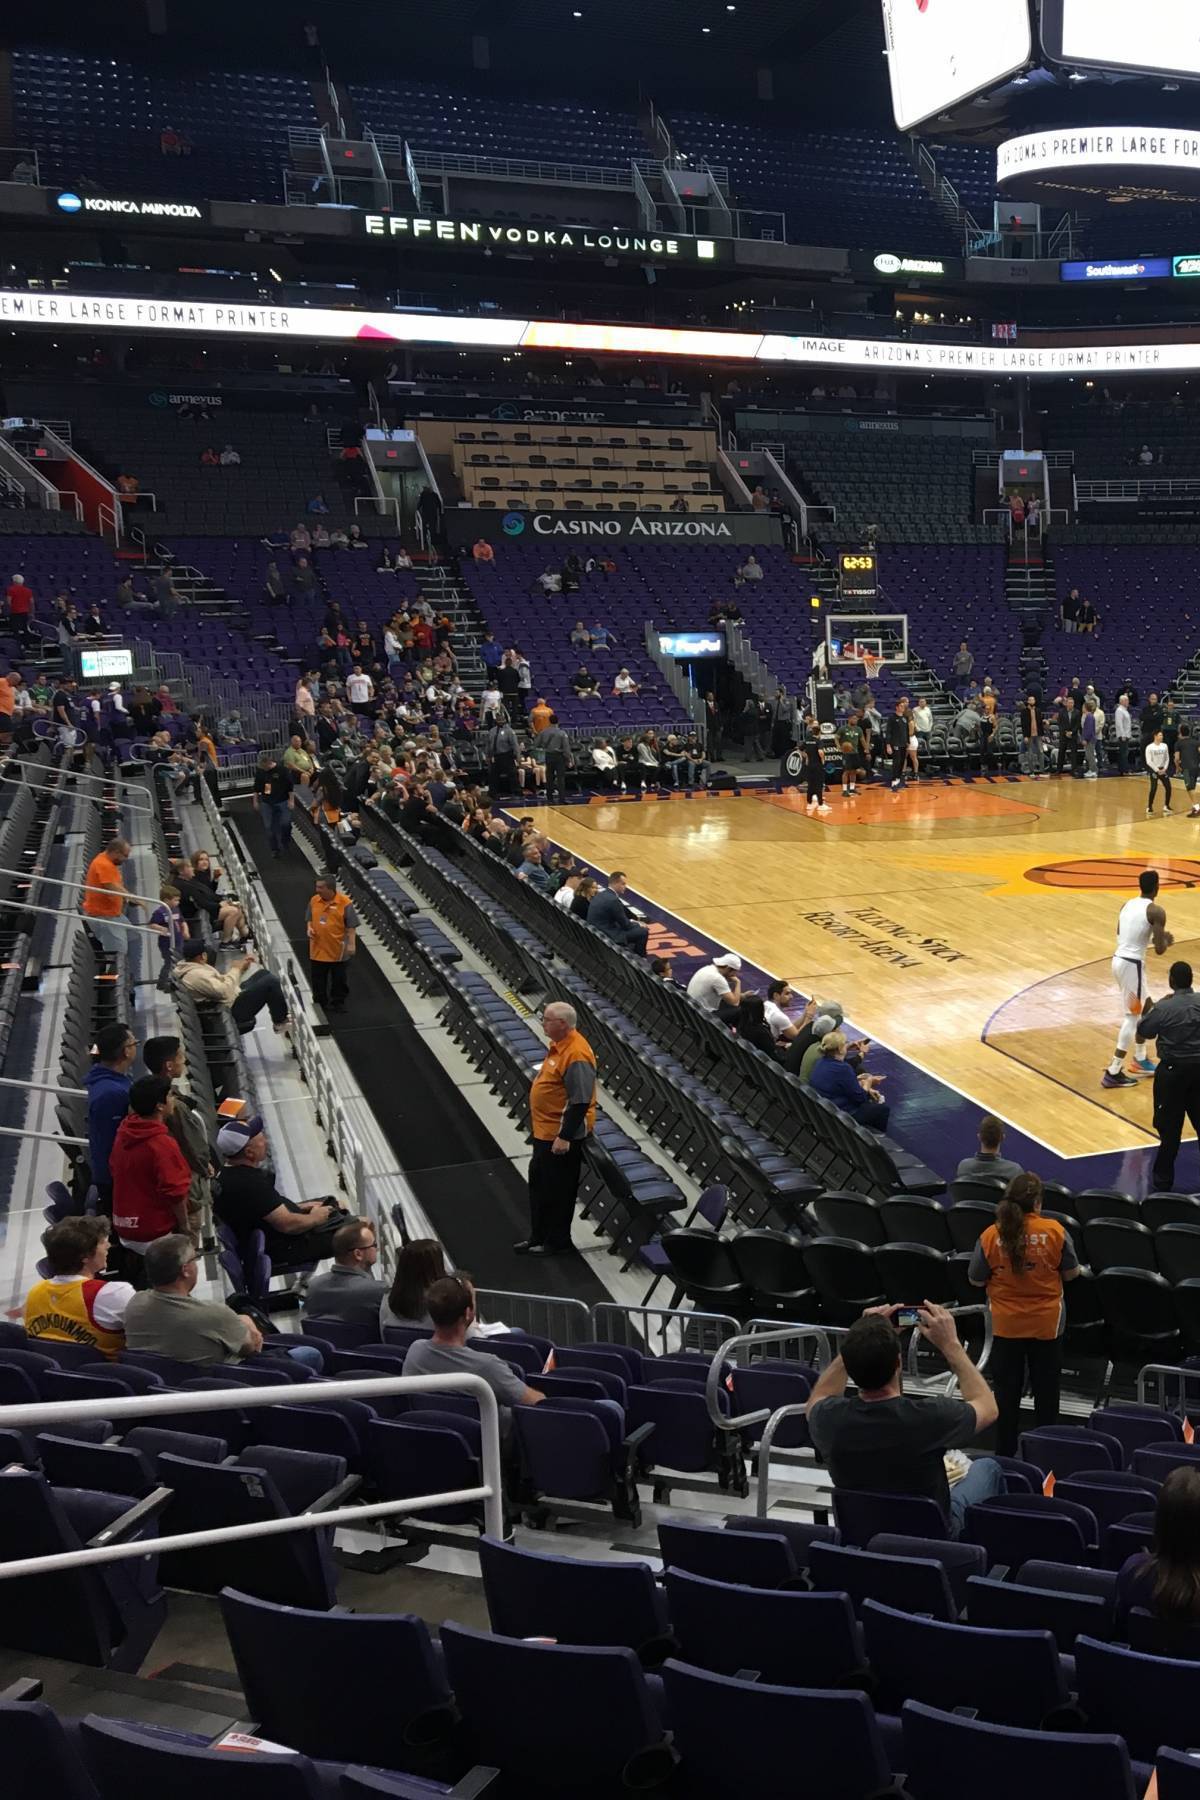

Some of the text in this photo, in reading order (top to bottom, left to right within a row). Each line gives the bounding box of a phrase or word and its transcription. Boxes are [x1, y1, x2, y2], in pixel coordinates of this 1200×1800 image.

[1053, 137, 1114, 157] PREMIER
[1122, 137, 1167, 154] LARGE
[84, 198, 202, 218] KONICA MINOLTA
[365, 215, 678, 253] EFFEN VODKA LOUNGE
[1086, 263, 1138, 277] Southwest
[71, 301, 125, 320] LARGE
[137, 305, 205, 325] FORMAT
[215, 309, 290, 329] PRINTER
[802, 340, 847, 352] IMAGE
[1003, 351, 1043, 367] LARGE
[1051, 351, 1098, 366] FORMAT
[1106, 349, 1160, 364] PRINTER
[169, 393, 223, 406] annexus
[843, 556, 873, 569] 62:53
[797, 911, 924, 969] RESORT ARENA
[845, 906, 973, 963] TALKING STICK
